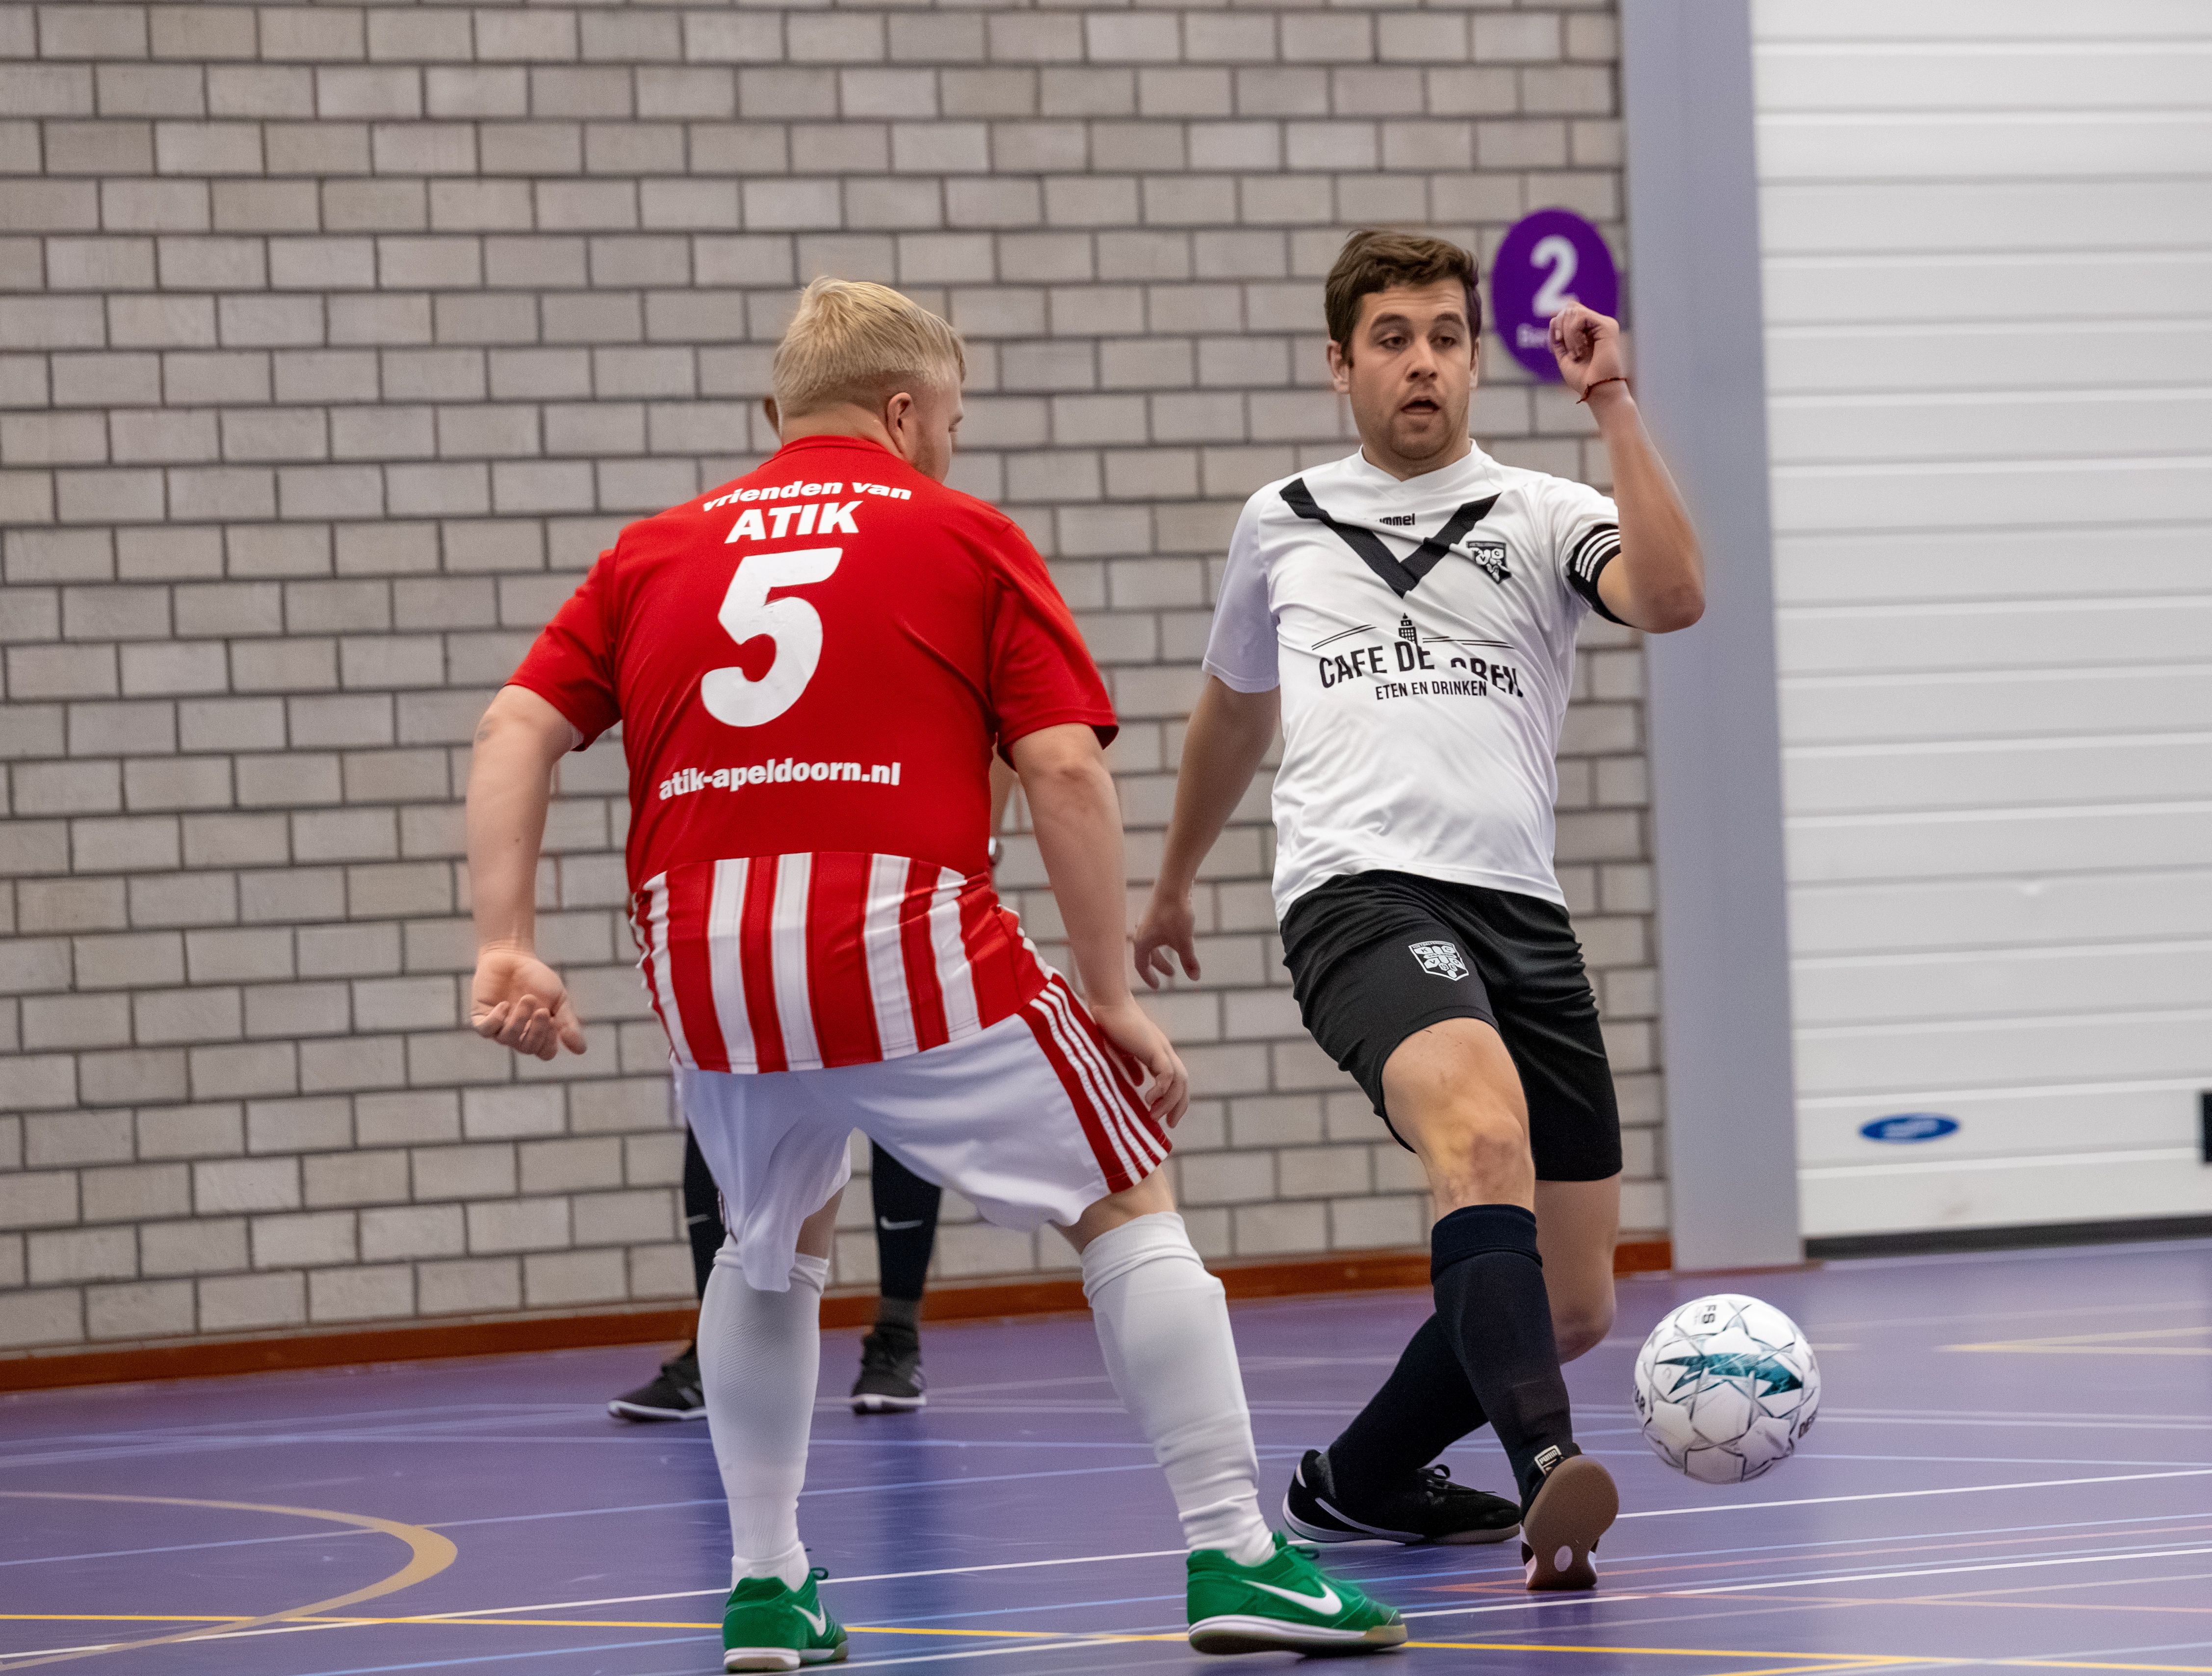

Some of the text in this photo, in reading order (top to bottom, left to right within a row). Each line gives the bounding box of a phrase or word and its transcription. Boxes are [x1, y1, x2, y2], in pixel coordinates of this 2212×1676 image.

[1530, 235, 1578, 318] 2
[703, 480, 912, 512] vrienden van
[724, 500, 863, 544] ATIK
[701, 547, 843, 727] 5
[1319, 646, 1387, 688] CAFE
[1394, 641, 1435, 672] DE
[1376, 681, 1487, 700] ETEN EN DRINKEN
[659, 758, 901, 800] atik-apeldoorn.nl
